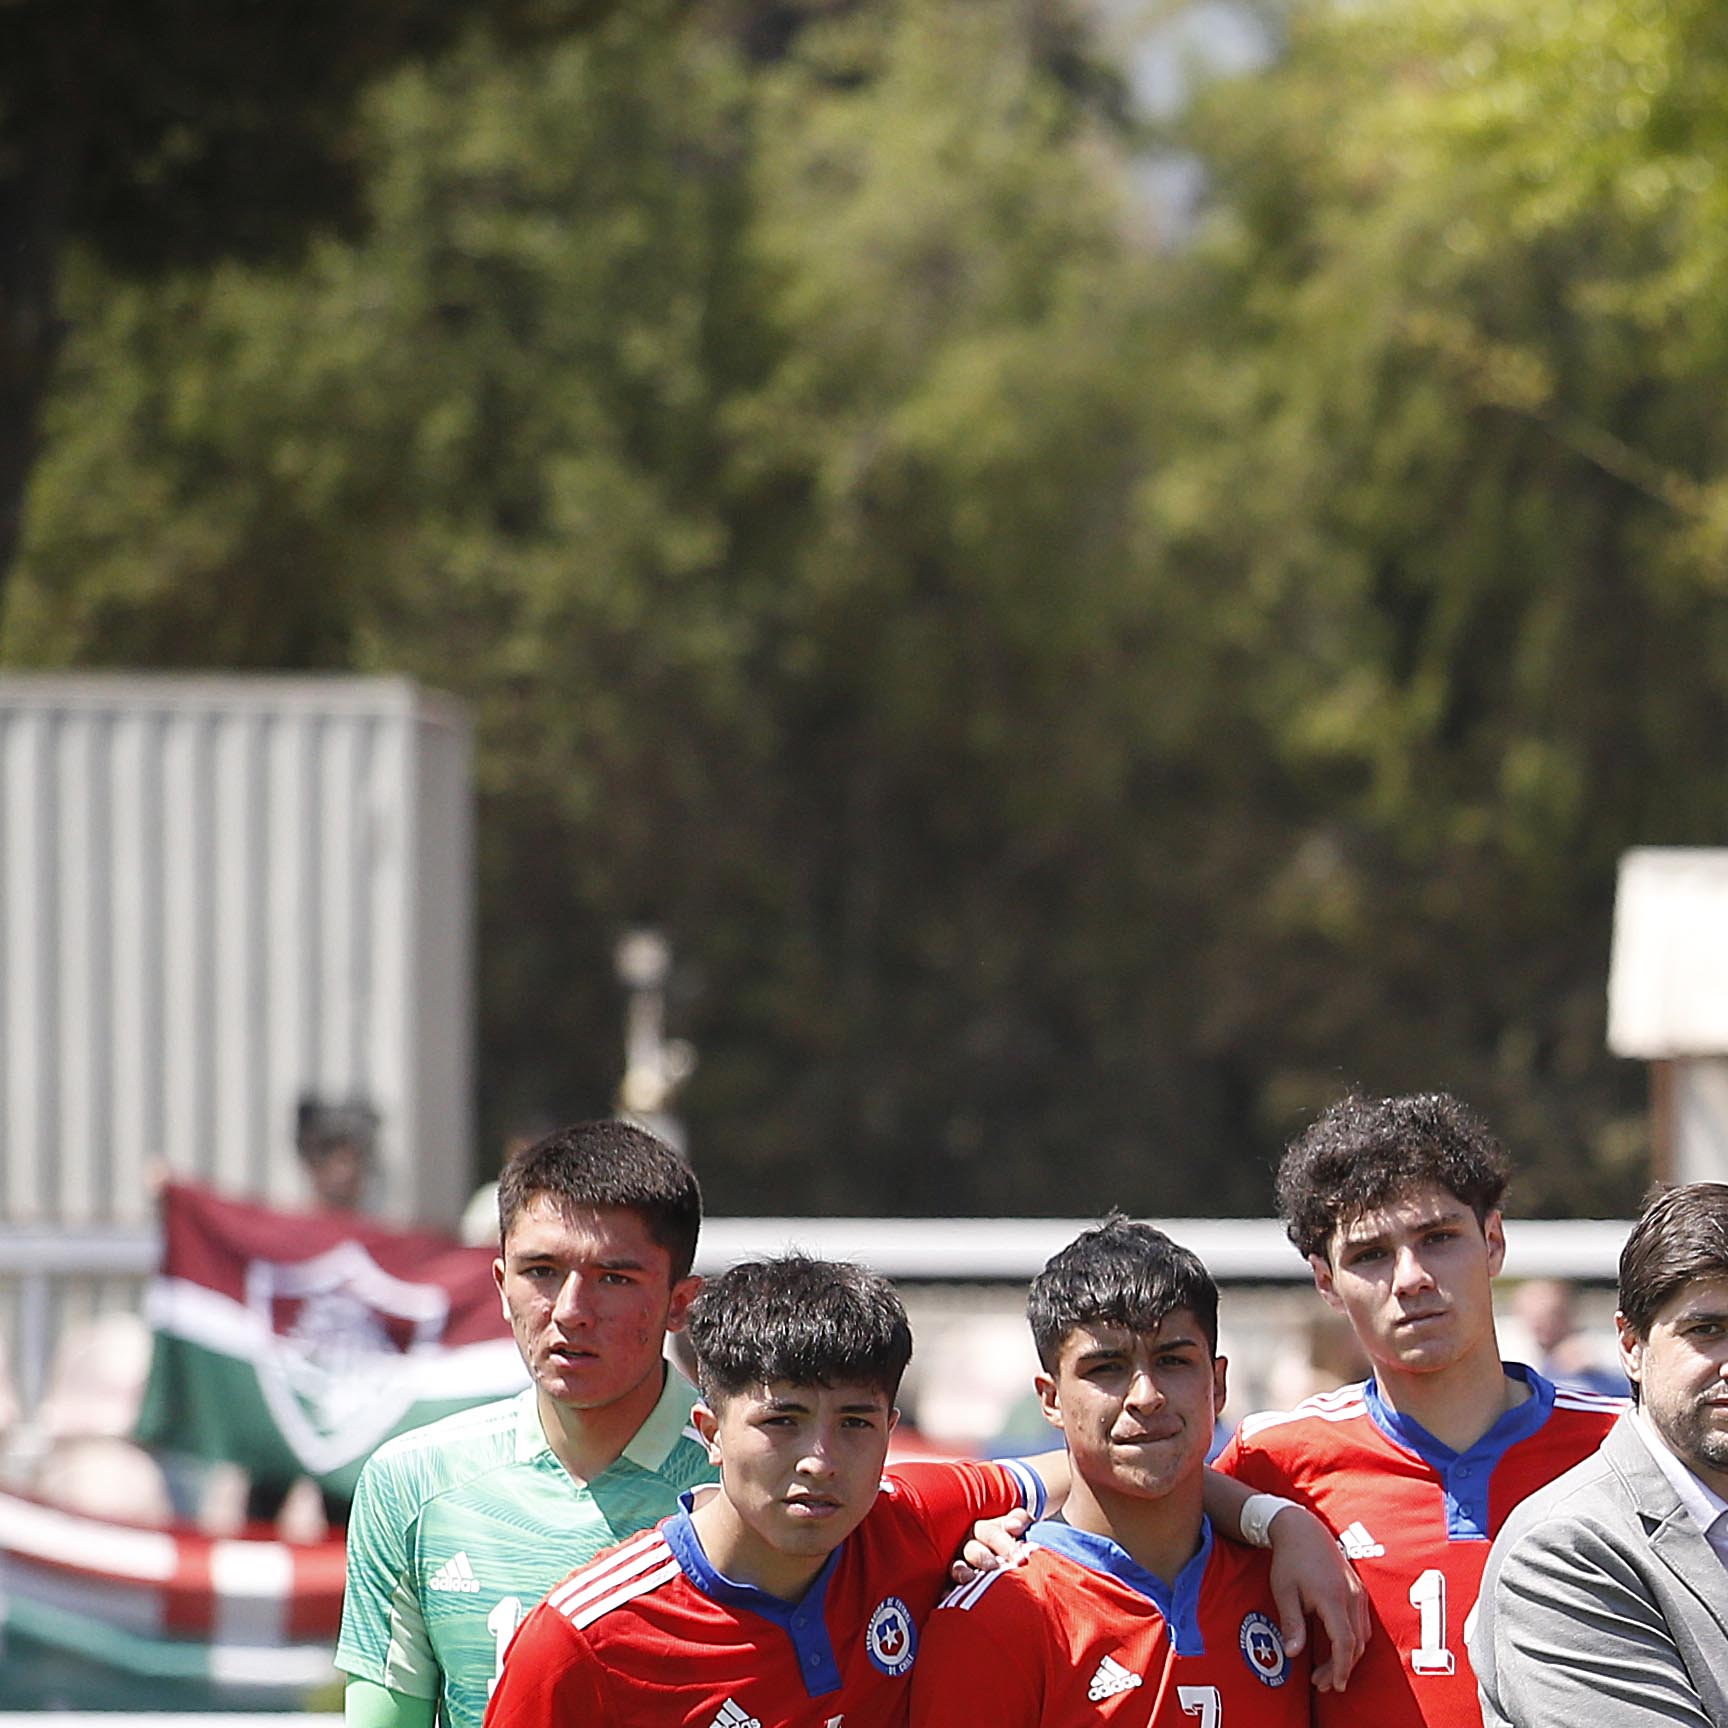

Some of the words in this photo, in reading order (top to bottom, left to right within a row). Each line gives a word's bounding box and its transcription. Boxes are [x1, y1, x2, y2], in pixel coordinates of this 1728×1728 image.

[430, 1577, 480, 1593] adidas
[1409, 1569, 1478, 1676] 1
[1088, 1673, 1143, 1702] adidas
